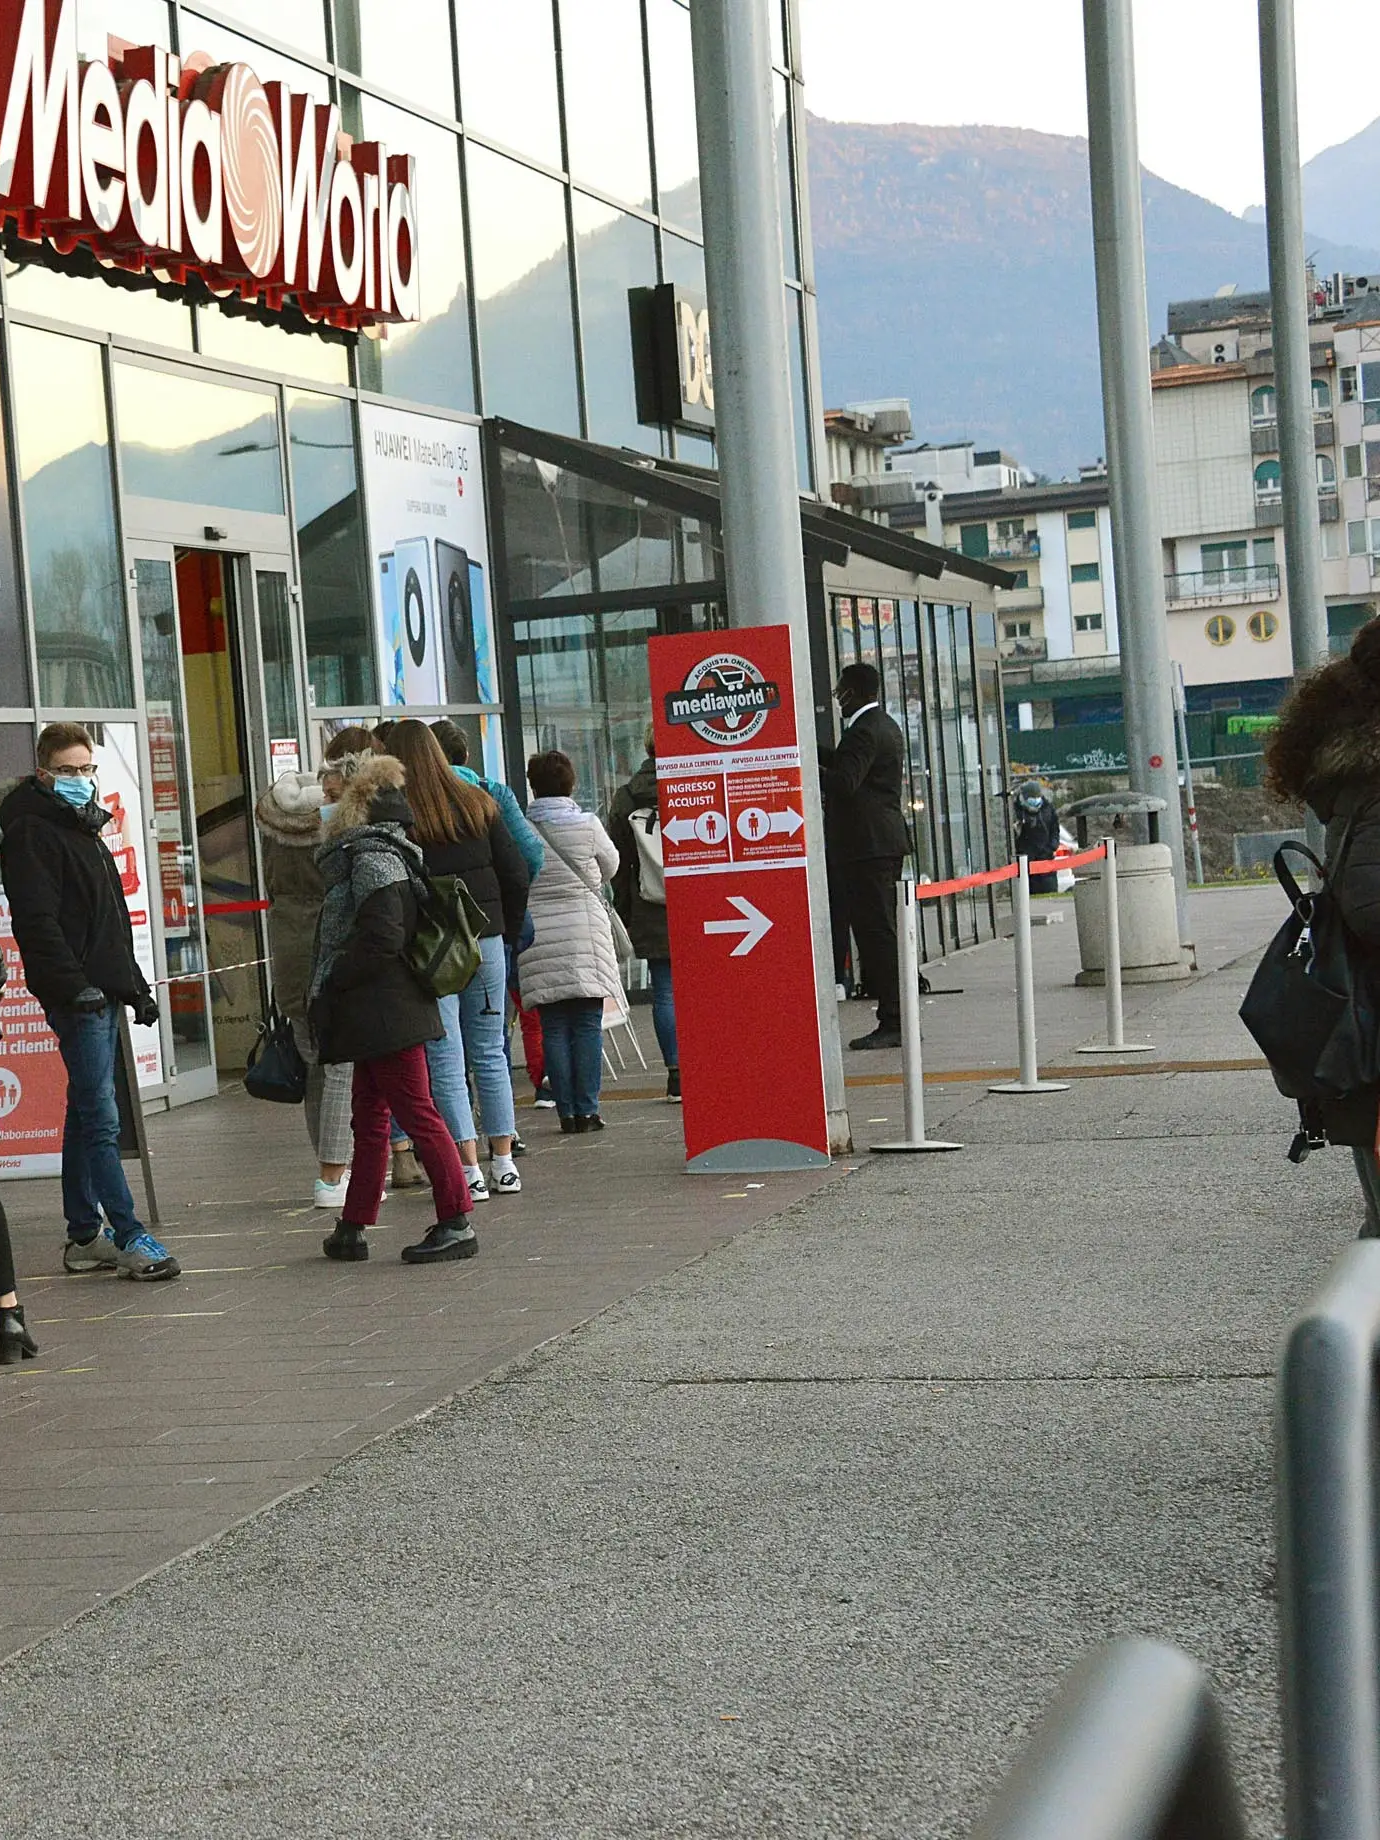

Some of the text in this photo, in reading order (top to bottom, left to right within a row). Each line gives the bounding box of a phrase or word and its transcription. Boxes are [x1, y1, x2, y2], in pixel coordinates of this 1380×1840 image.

[374, 431, 412, 461] HUAWEI
[413, 439, 441, 466] Mate40
[457, 447, 468, 471] 5G
[694, 658, 756, 680] ACQUISTA ONLINE
[701, 726, 728, 741] RITIRA
[657, 759, 724, 771] AVVISO ALLA CLIENTELA
[731, 756, 754, 764] AVVISO
[754, 755, 769, 763] ALLA
[666, 781, 716, 794] INGRESSO
[668, 796, 714, 808] ACQUISTI
[7, 949, 20, 963] la
[6, 1023, 24, 1035] un
[28, 1020, 53, 1033] nu
[10, 1037, 58, 1054] clienti.
